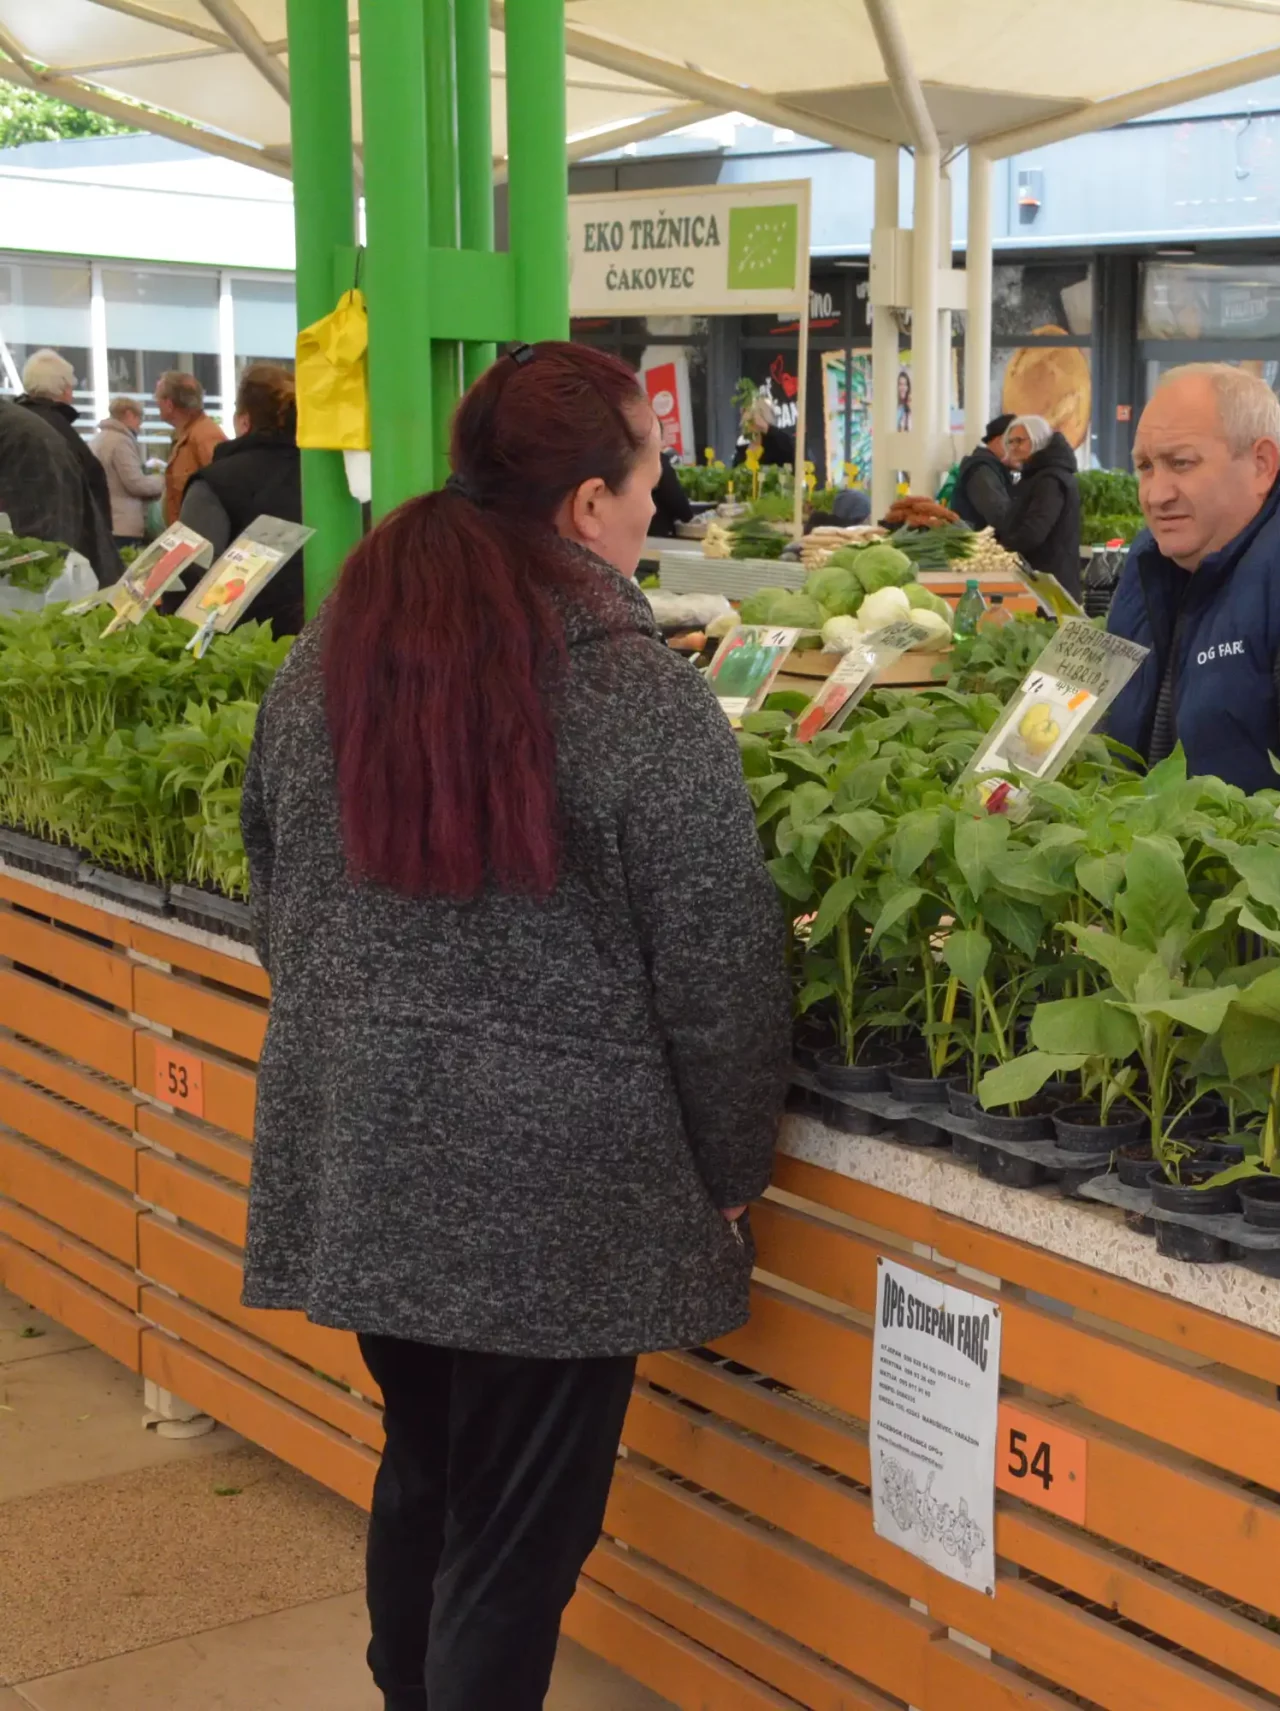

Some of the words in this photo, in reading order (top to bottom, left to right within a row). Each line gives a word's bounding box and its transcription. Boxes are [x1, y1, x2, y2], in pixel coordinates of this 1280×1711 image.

[584, 221, 624, 253] EKO
[630, 209, 721, 250] TRŽNICA
[605, 264, 695, 291] ČAKOVEC
[168, 1061, 189, 1098] 53
[882, 1272, 905, 1329] OPG
[906, 1293, 955, 1347] STJEPAN
[957, 1313, 990, 1373] FARC
[1007, 1428, 1054, 1490] 54
